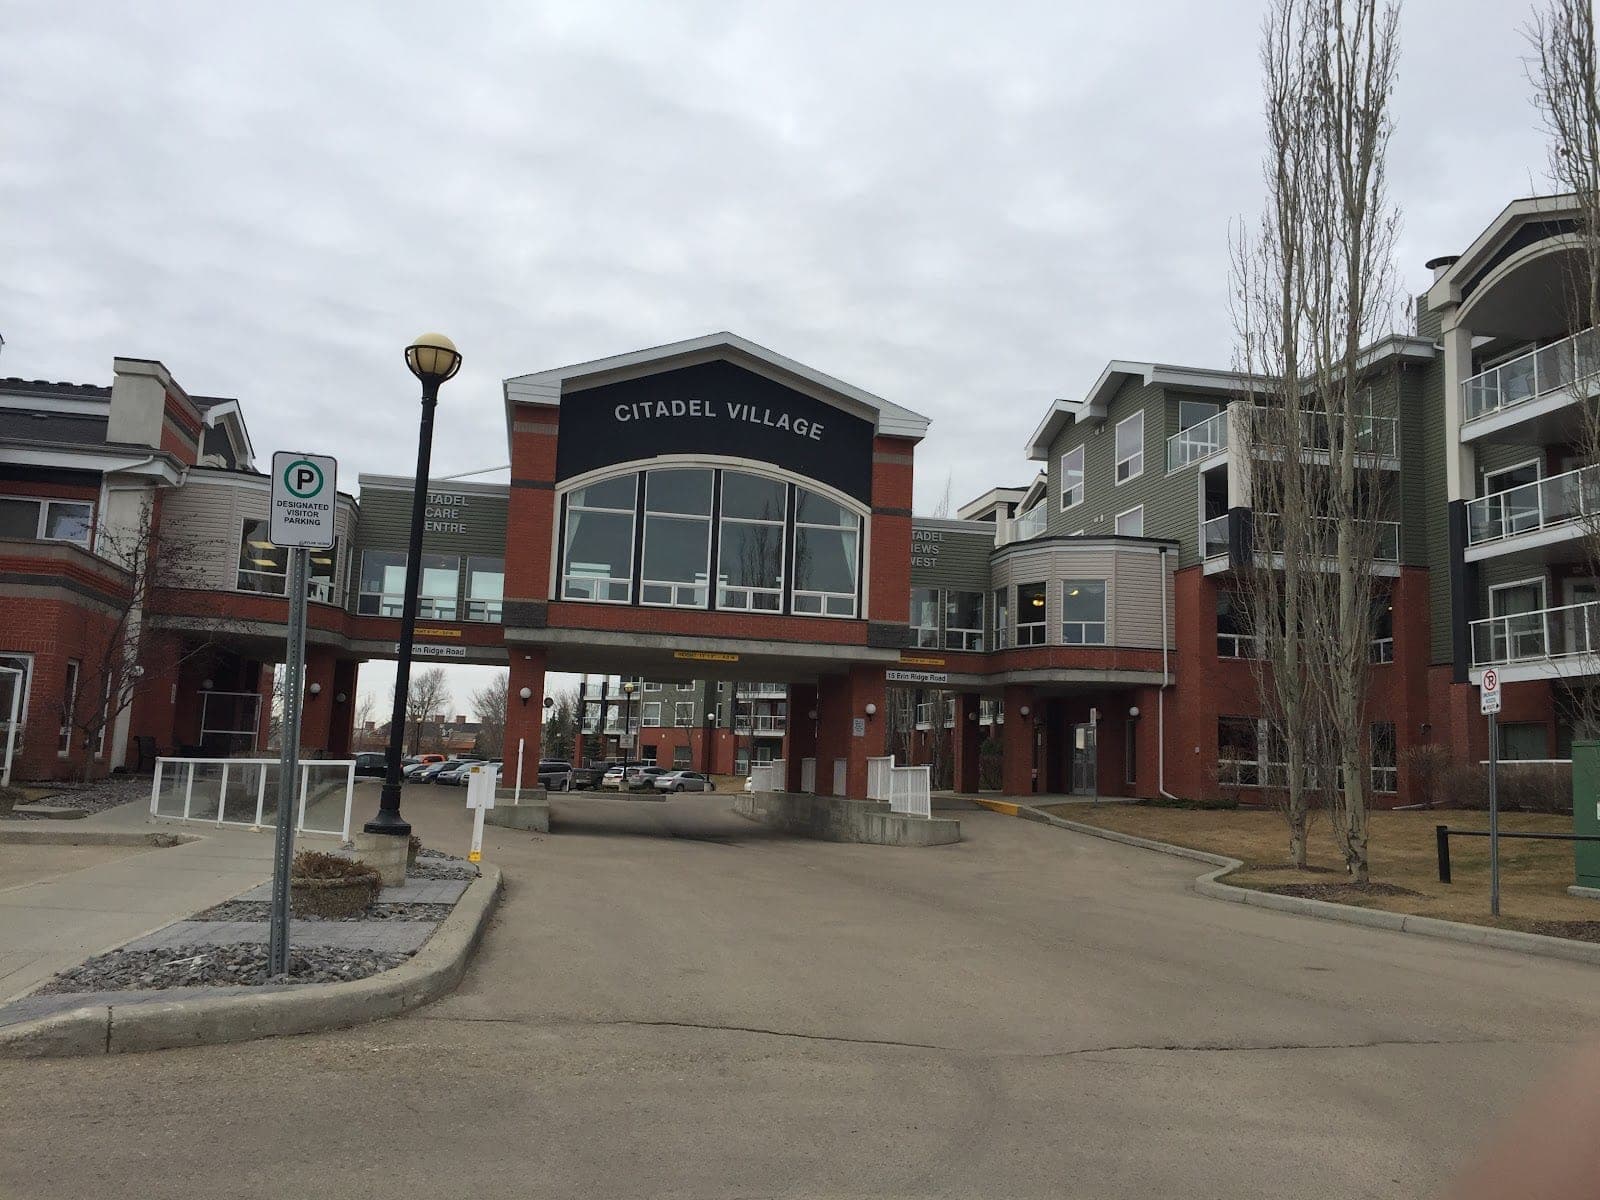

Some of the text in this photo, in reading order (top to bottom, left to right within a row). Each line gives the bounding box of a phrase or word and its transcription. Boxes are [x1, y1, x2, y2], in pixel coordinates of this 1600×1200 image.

[614, 400, 825, 440] CITADEL VILLAGE
[296, 468, 315, 490] P
[276, 500, 329, 511] DESIGNATED
[427, 494, 469, 506] TADEL
[286, 509, 320, 518] VISITOR
[424, 507, 460, 519] CARE
[284, 516, 321, 526] PARKING
[424, 520, 467, 534] ENTRE
[911, 530, 945, 542] TADEL
[911, 543, 940, 555] IEWS
[412, 646, 465, 656] rin Ridge Road
[929, 674, 946, 682] Road
